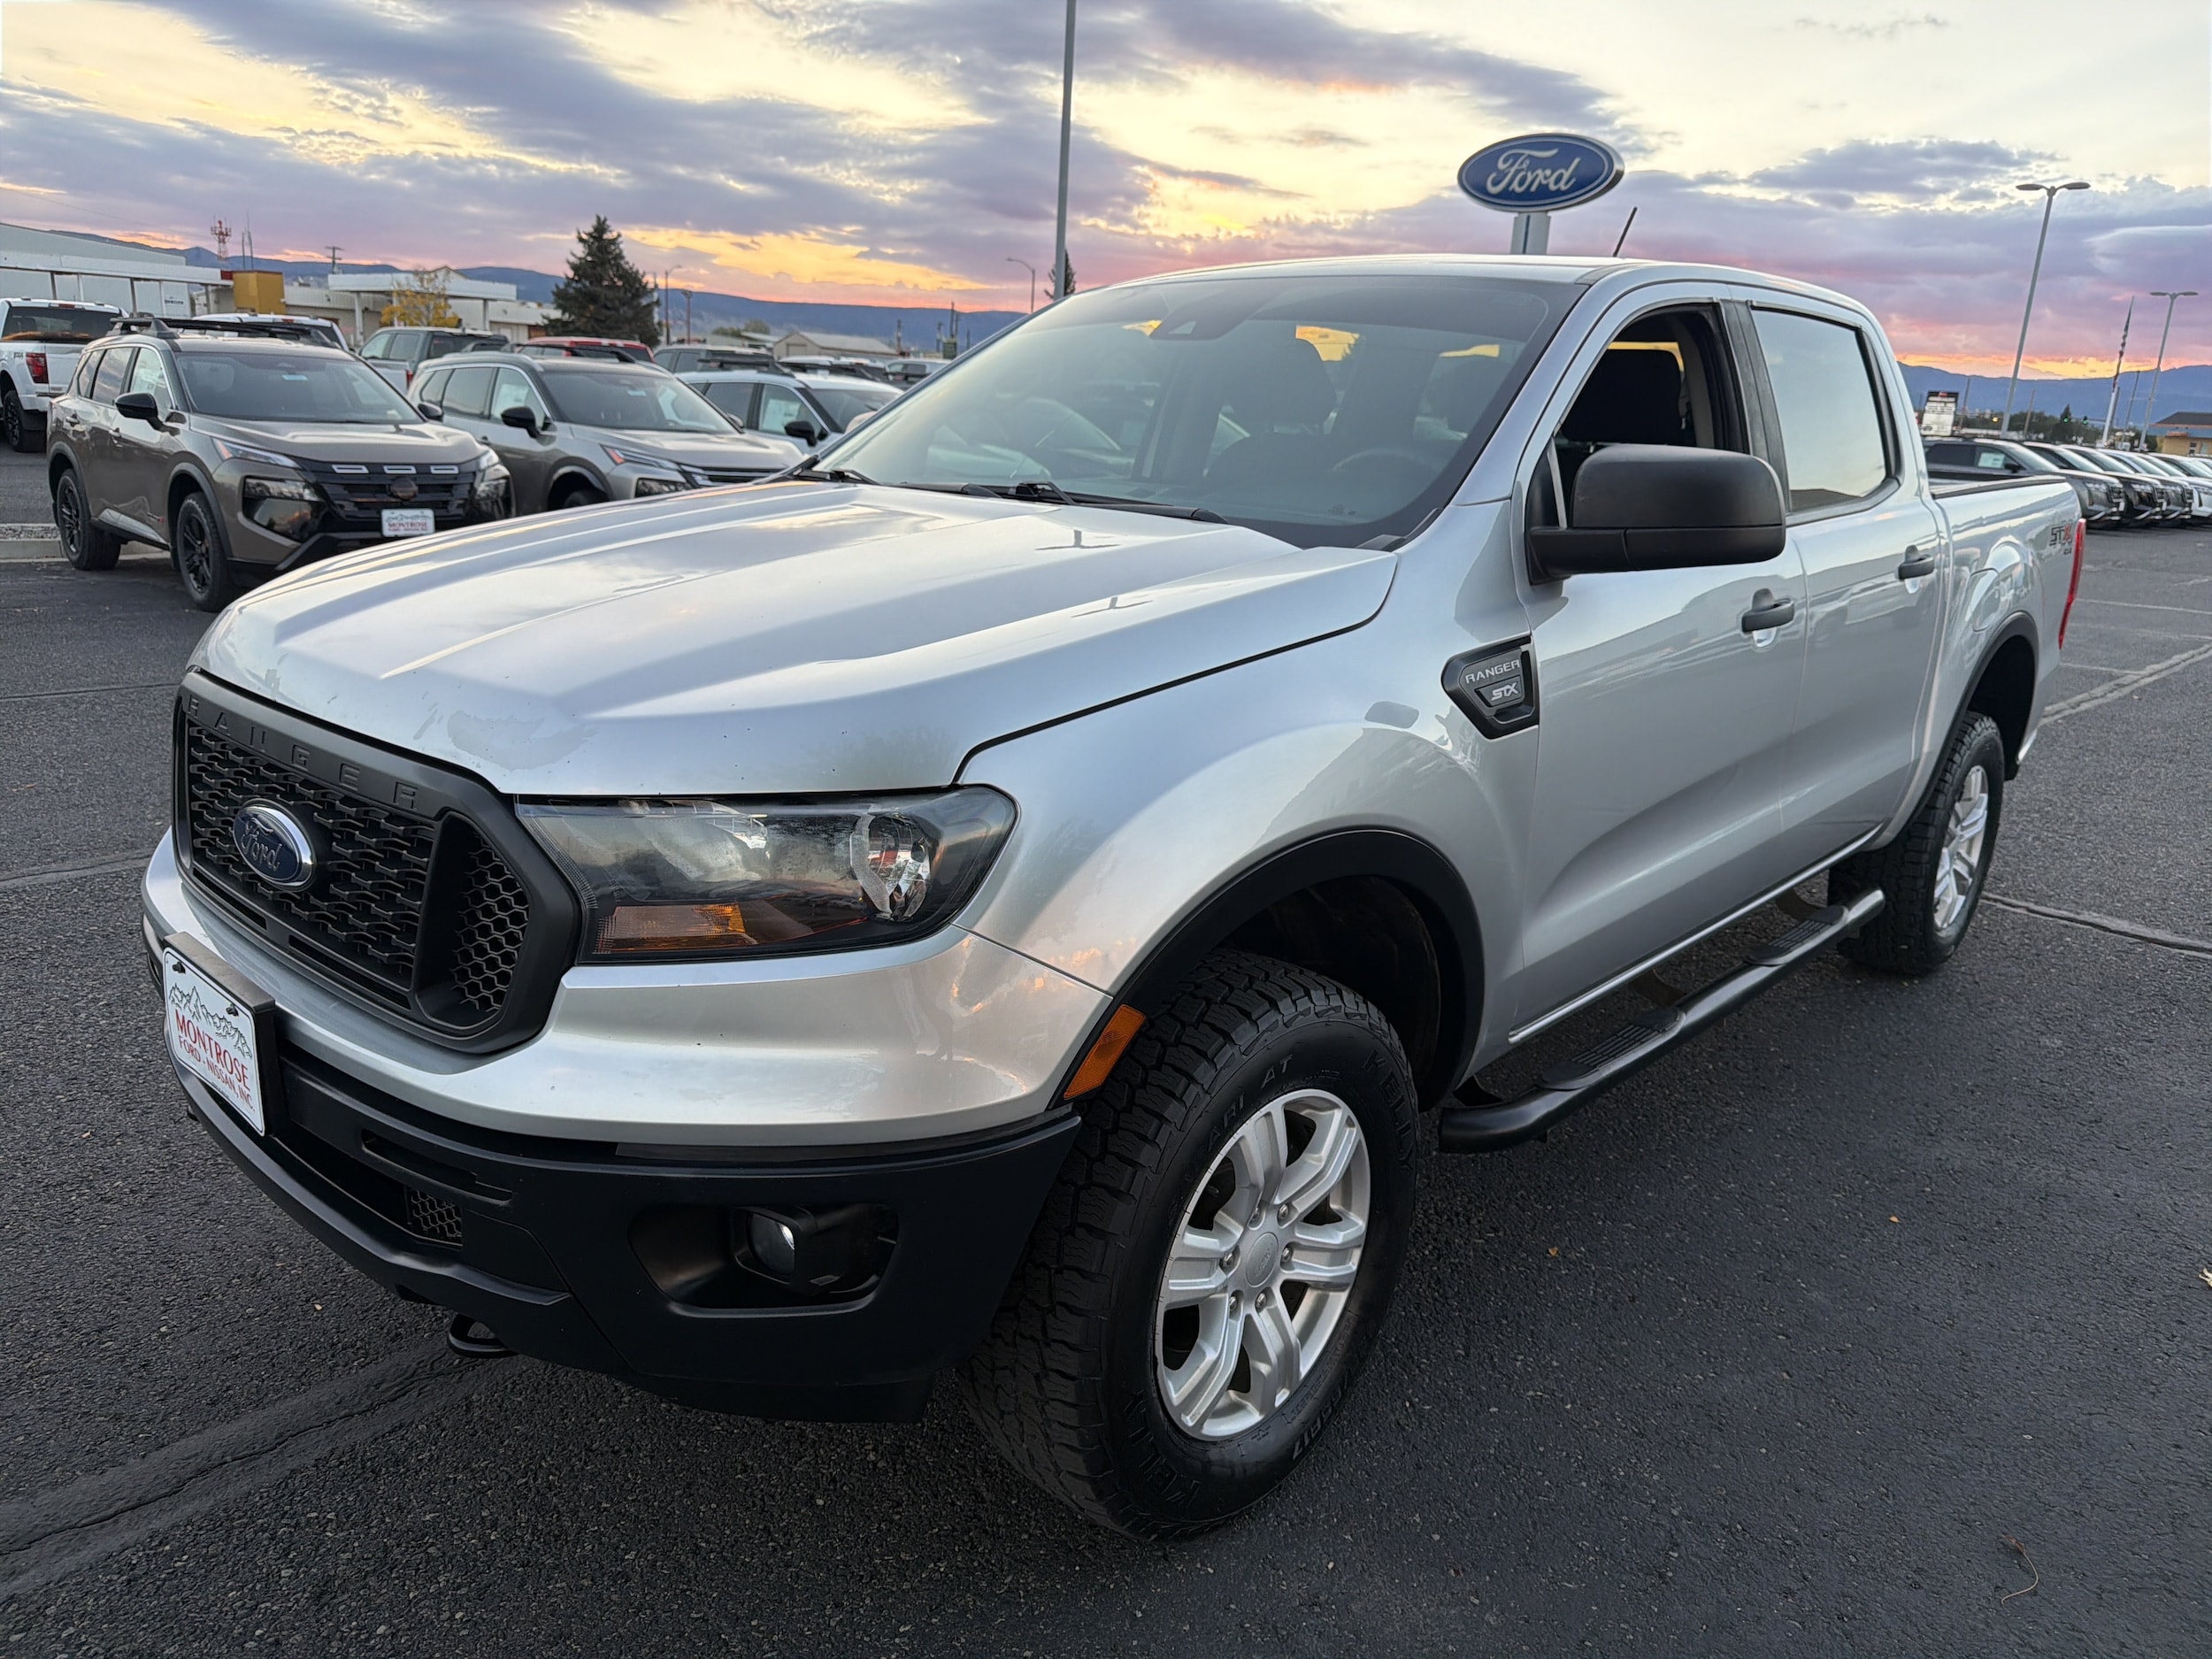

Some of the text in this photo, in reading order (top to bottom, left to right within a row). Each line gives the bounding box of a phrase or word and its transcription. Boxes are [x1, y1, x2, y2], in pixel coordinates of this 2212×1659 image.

[1486, 148, 1581, 195] Ford
[2048, 519, 2073, 546] STX
[1464, 659, 1520, 684] RANGER
[1491, 682, 1519, 702] STX
[241, 817, 282, 872] Ford
[174, 1009, 251, 1092] MONTROSE
[178, 1035, 201, 1063] FORD
[206, 1060, 238, 1099] NISSAN,
[237, 1087, 256, 1112] INC.
[1260, 1054, 1294, 1090] AT
